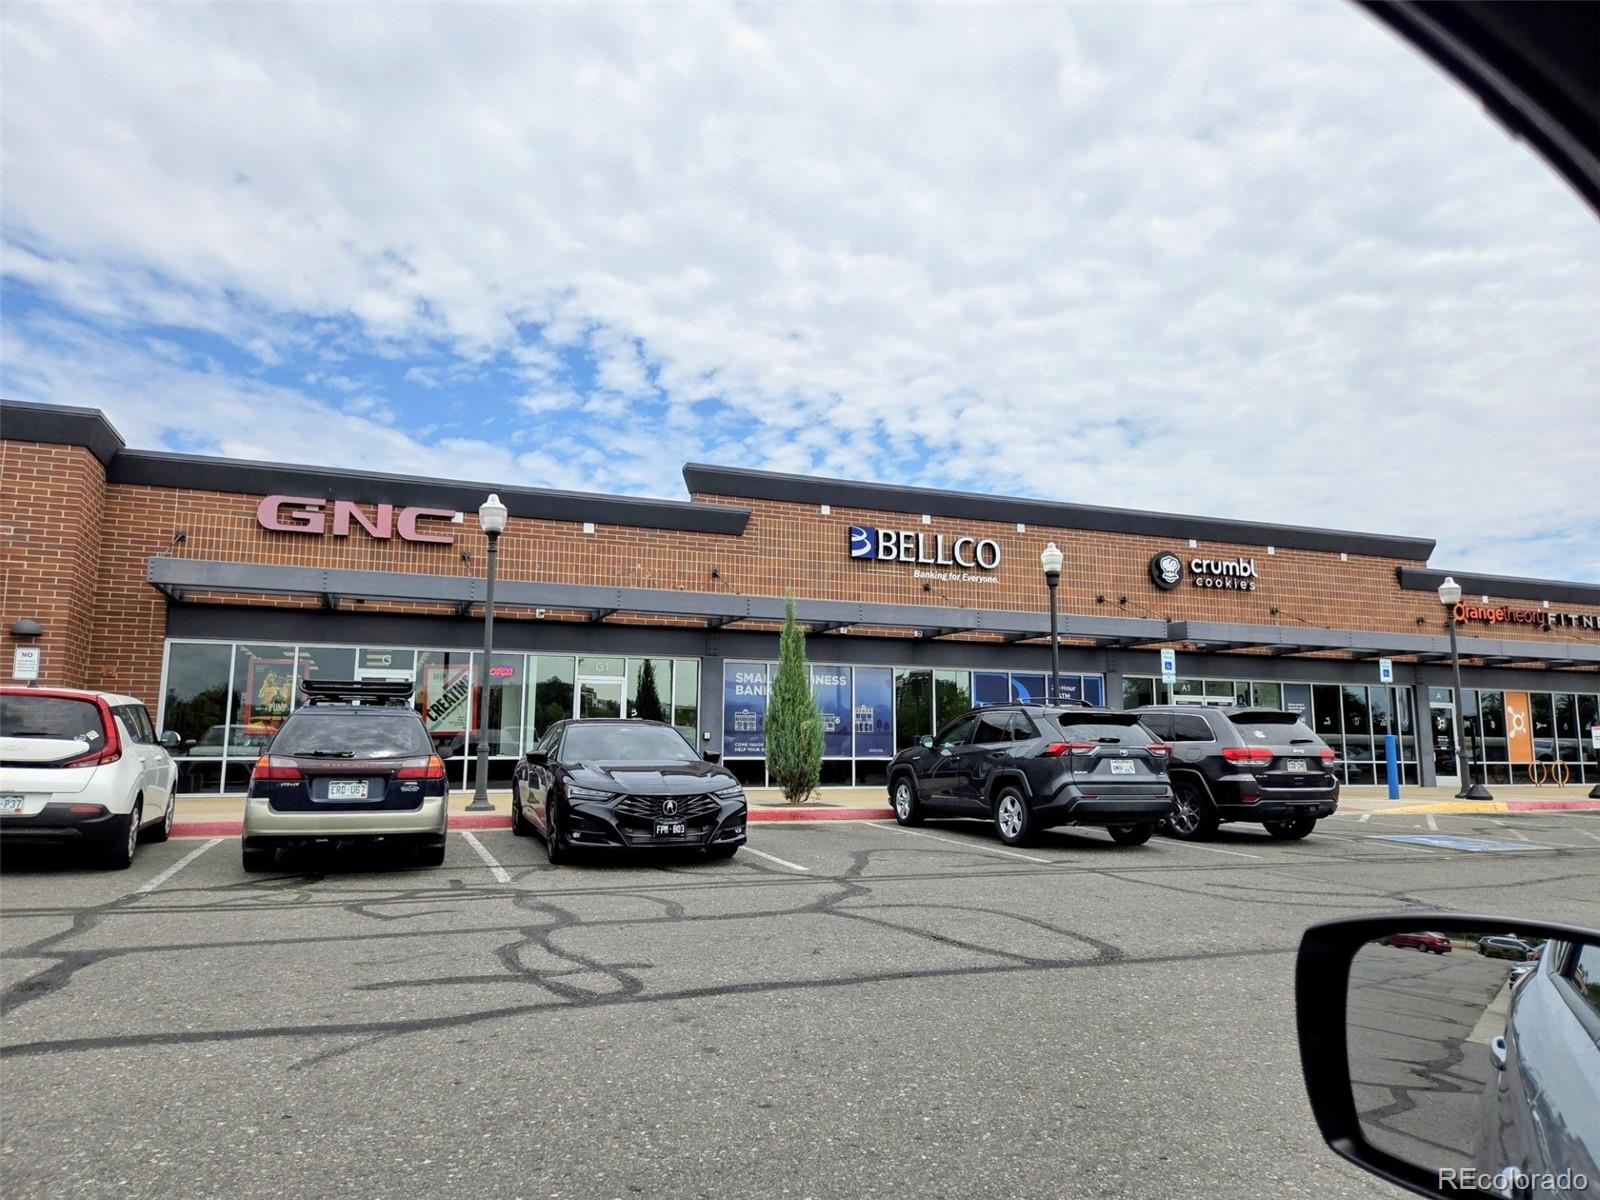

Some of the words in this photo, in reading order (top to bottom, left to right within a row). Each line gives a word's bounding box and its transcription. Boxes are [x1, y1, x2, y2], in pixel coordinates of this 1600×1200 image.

[257, 495, 456, 544] GNC
[877, 529, 1001, 569] BELLCO
[1190, 558, 1258, 578] crumbl
[913, 569, 947, 581] Banking
[949, 572, 961, 581] for
[962, 573, 1000, 584] Everyone.
[1196, 577, 1256, 590] cookies
[382, 654, 392, 665] G
[735, 672, 776, 684] SMAL
[1181, 684, 1191, 692] A1
[426, 673, 469, 722] CREATIN
